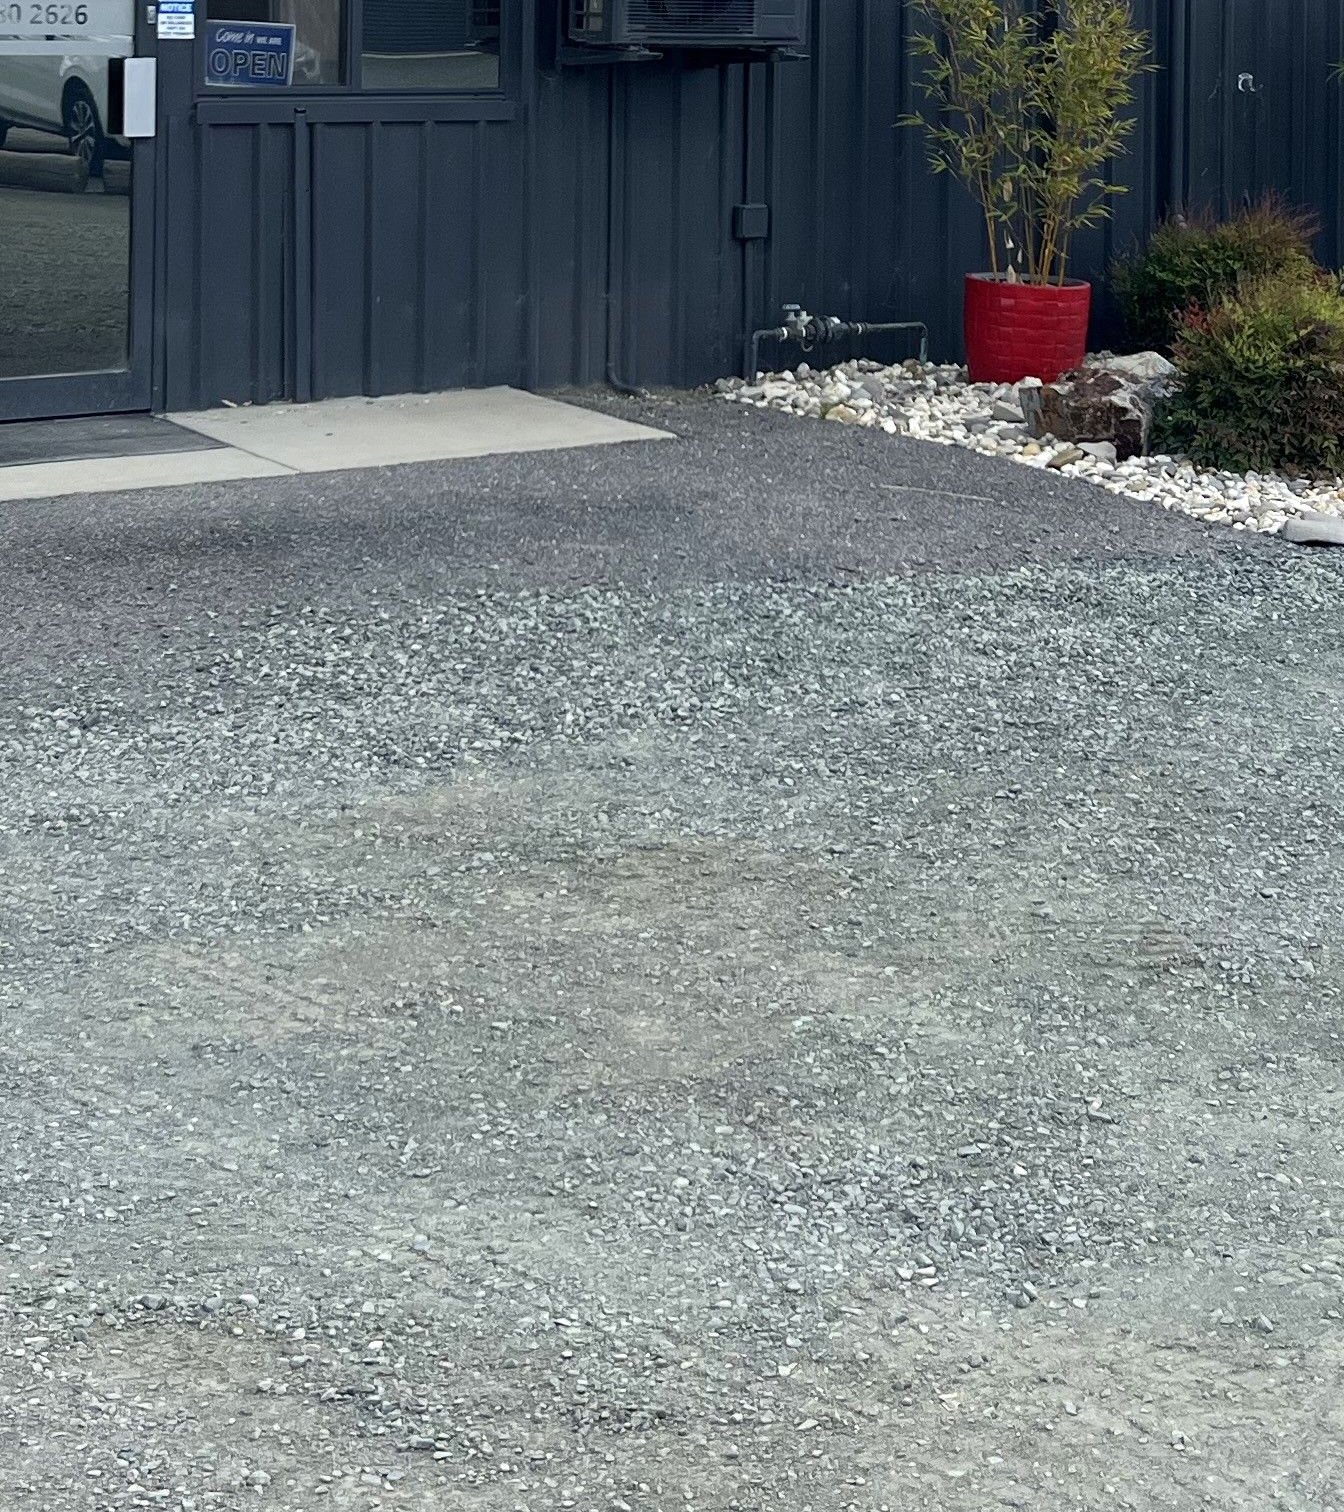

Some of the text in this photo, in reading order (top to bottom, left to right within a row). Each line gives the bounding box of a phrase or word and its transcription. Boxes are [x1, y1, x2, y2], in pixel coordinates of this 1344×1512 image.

[29, 3, 89, 25] 2626
[216, 28, 244, 43] Come
[244, 30, 255, 45] in
[209, 48, 287, 80] OPEN
